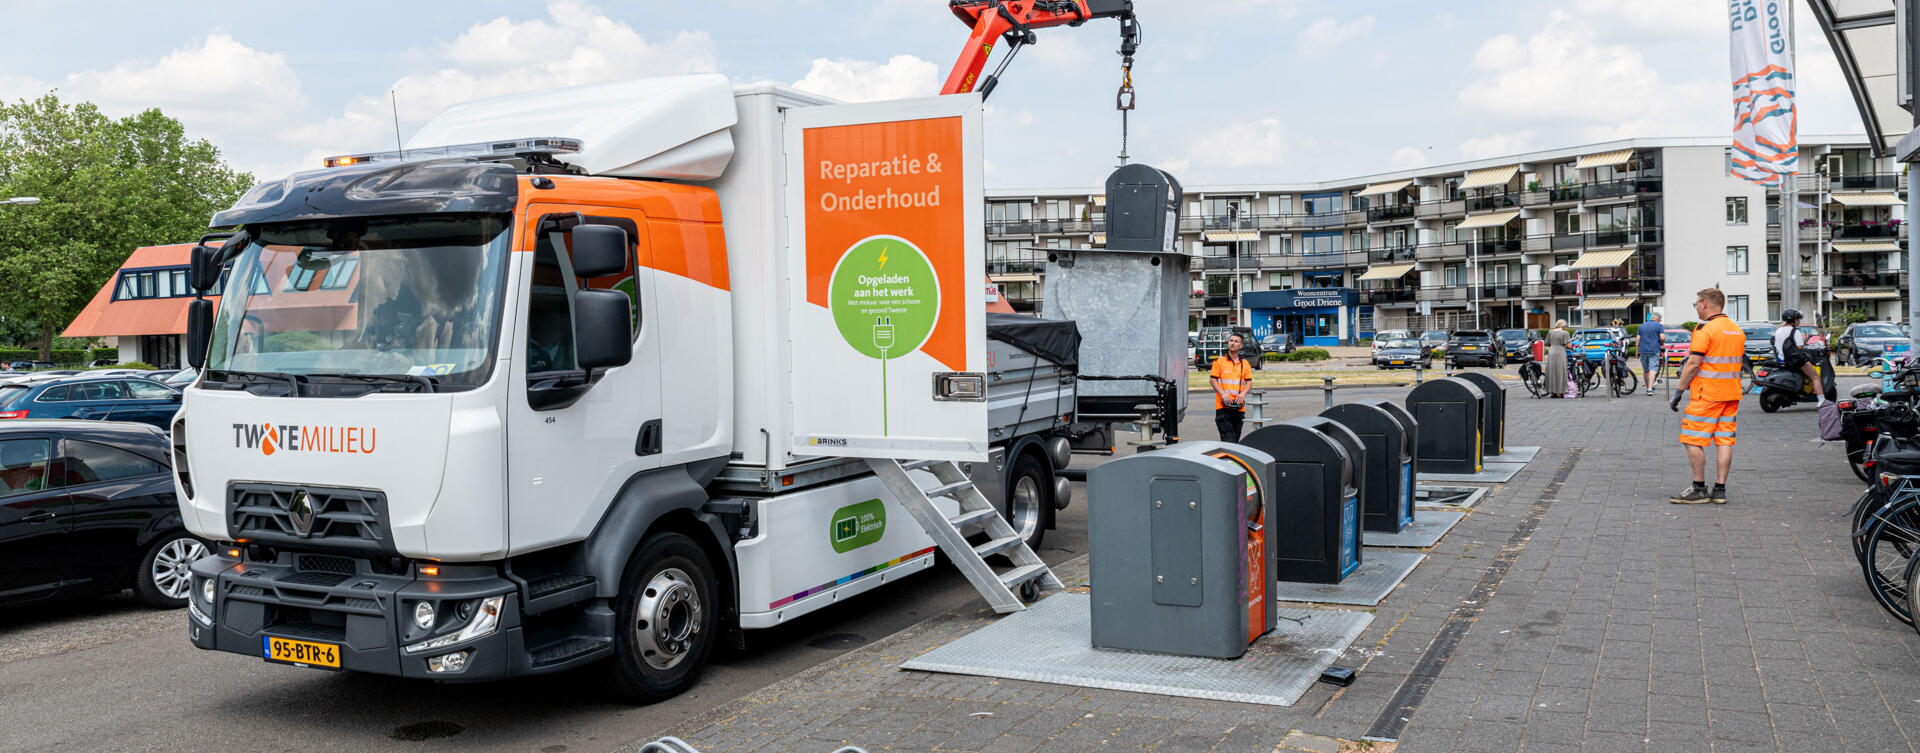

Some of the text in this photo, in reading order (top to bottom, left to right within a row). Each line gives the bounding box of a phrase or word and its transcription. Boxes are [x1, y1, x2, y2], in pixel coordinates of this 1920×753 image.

[820, 153, 942, 184] Reparatie &
[820, 184, 940, 212] Onderhoud
[858, 273, 910, 287] Opgeladen
[854, 286, 914, 297] aan het werk
[1294, 298, 1342, 307] Groot Driene
[1276, 319, 1282, 329] 6
[544, 416, 556, 425] 454
[817, 437, 847, 446] BRINKS
[273, 640, 335, 663] 95-BTR-6
